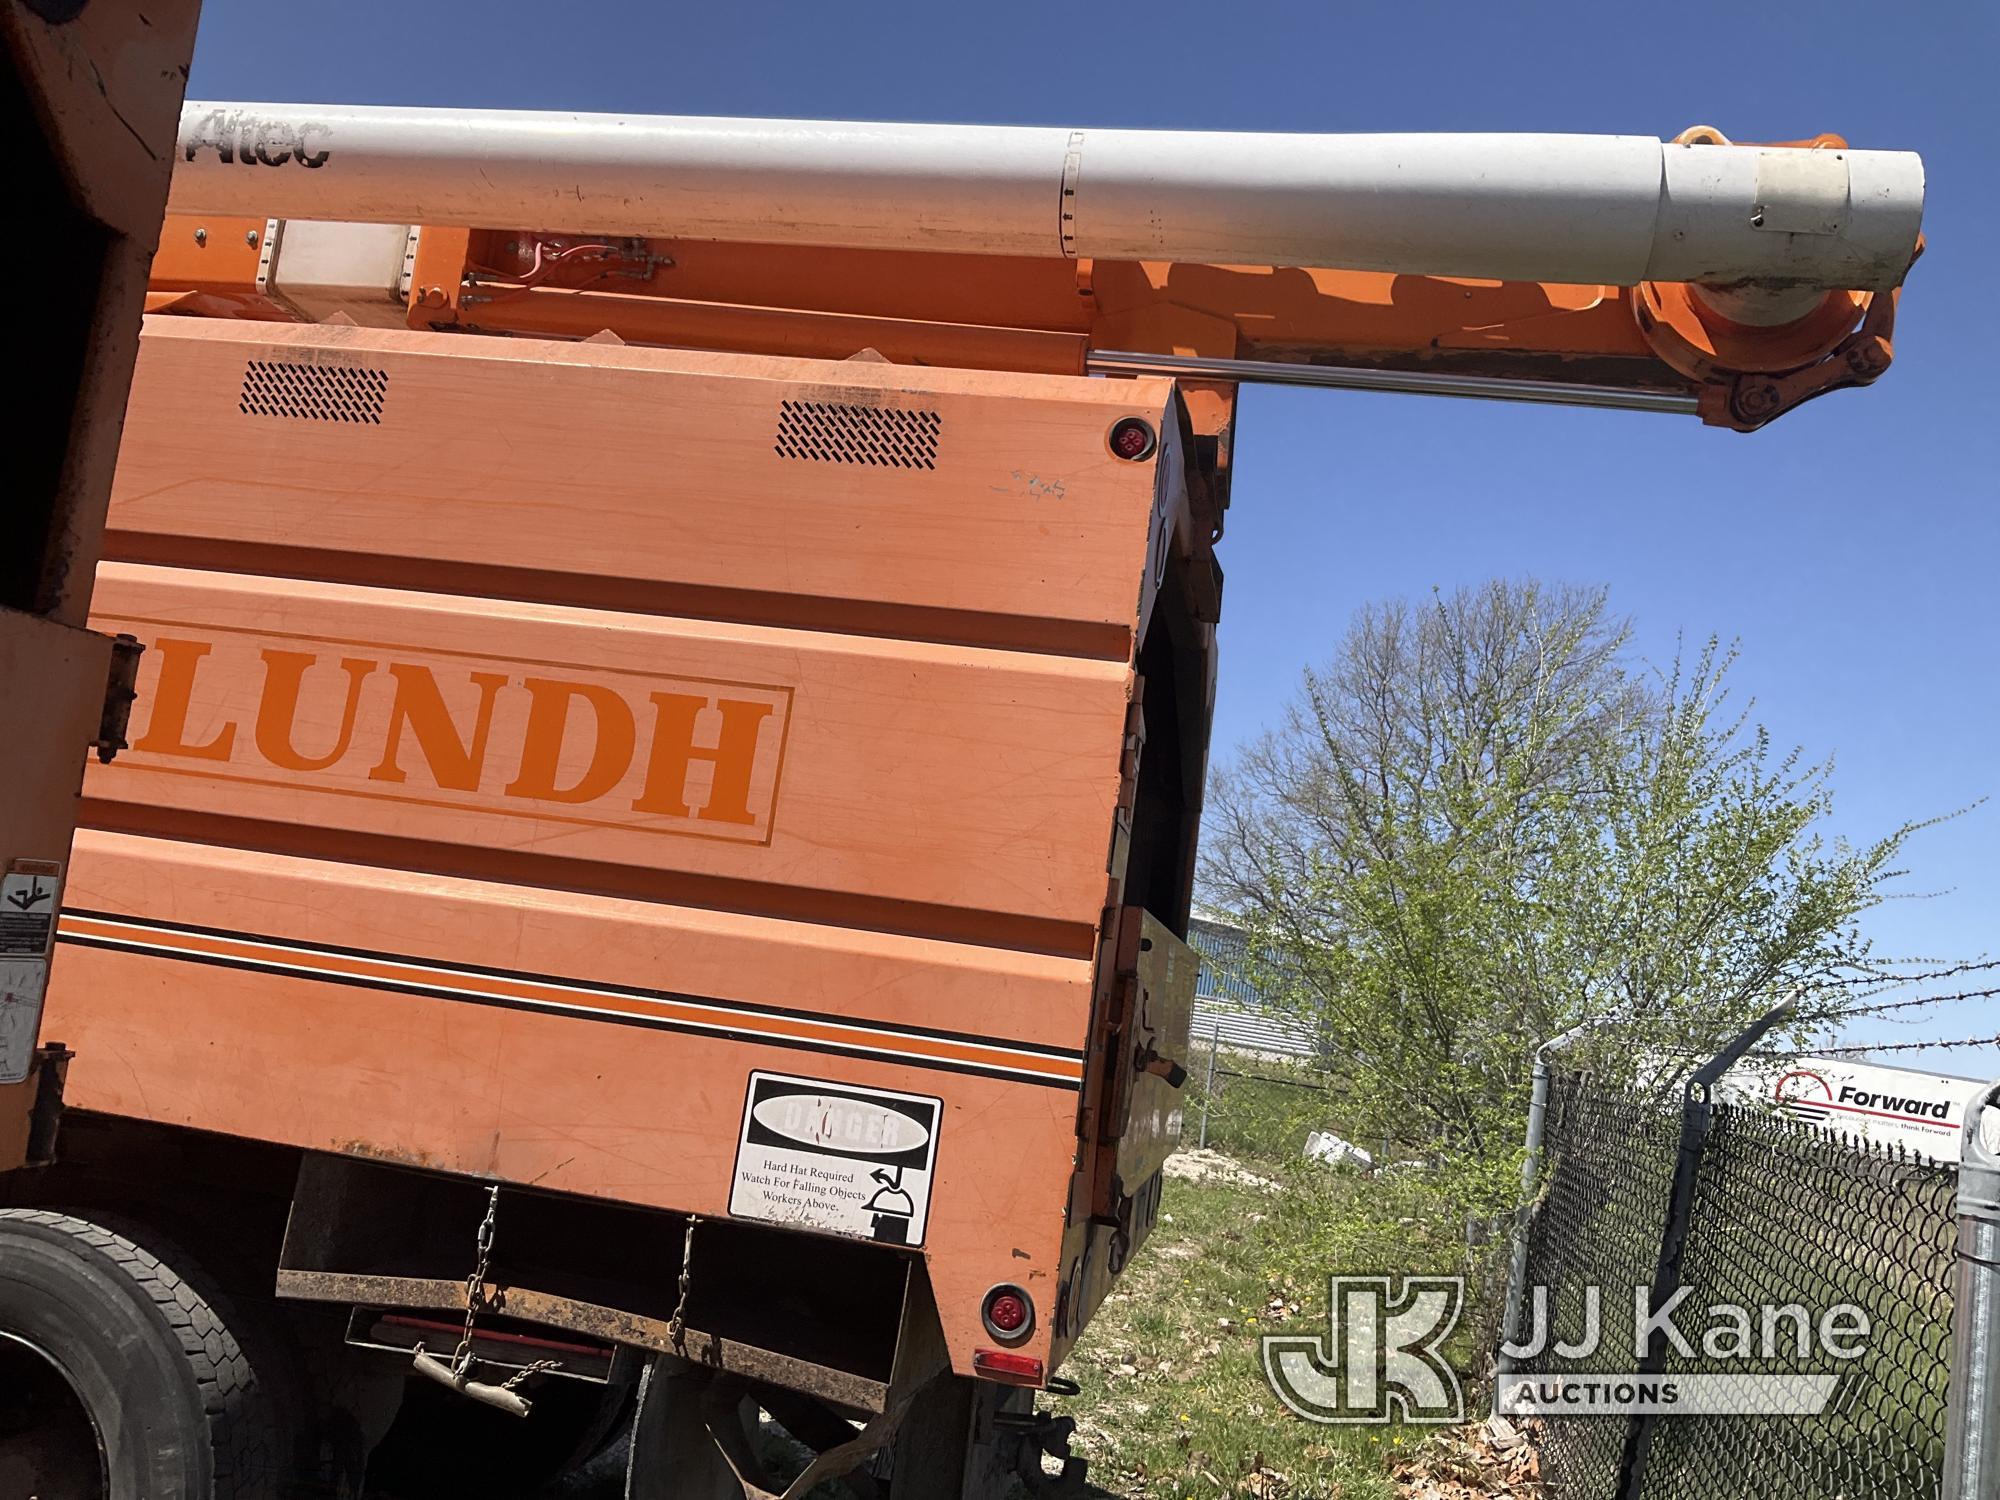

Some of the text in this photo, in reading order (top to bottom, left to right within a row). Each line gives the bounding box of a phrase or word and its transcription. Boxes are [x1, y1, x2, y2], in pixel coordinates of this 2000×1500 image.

[1838, 1086, 1951, 1119] Forward
[1900, 1123, 1920, 1131] think
[763, 1160, 854, 1183] Hard Hat Required
[741, 1171, 867, 1201] Watch For Falling Objects
[762, 1190, 840, 1212] Workers Above.
